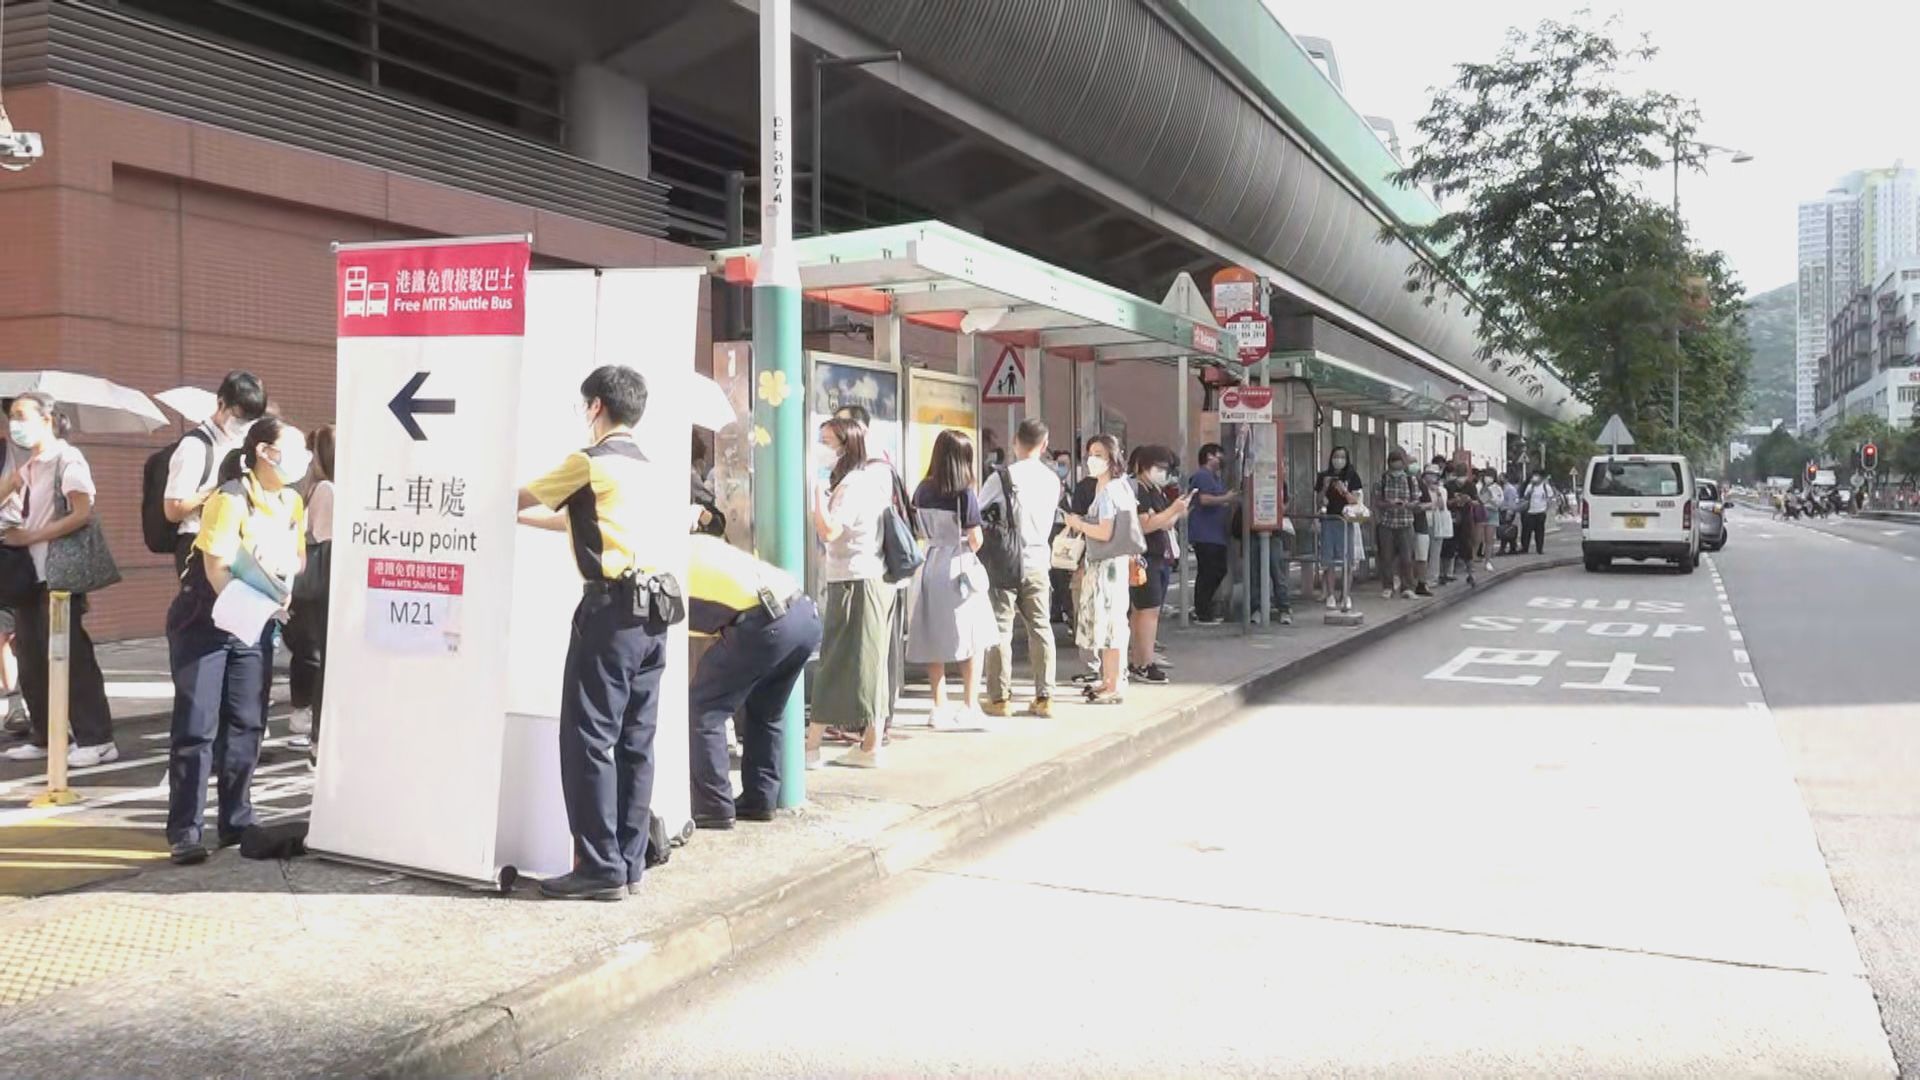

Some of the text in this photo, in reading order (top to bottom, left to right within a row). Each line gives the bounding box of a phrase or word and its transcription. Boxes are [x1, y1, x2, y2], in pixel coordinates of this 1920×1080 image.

[396, 266, 515, 293] 港鐵免費接駁巴士
[394, 295, 513, 312] Free MTR Shuttle Bus
[365, 474, 466, 517] 上車處
[352, 522, 477, 554] Pick-up point
[381, 578, 450, 592] Free MTR Shuttle Bus
[390, 601, 434, 625] M21
[1527, 597, 1685, 613] BUS
[1460, 616, 1706, 638] STOP
[1423, 647, 1675, 693] 巴士
